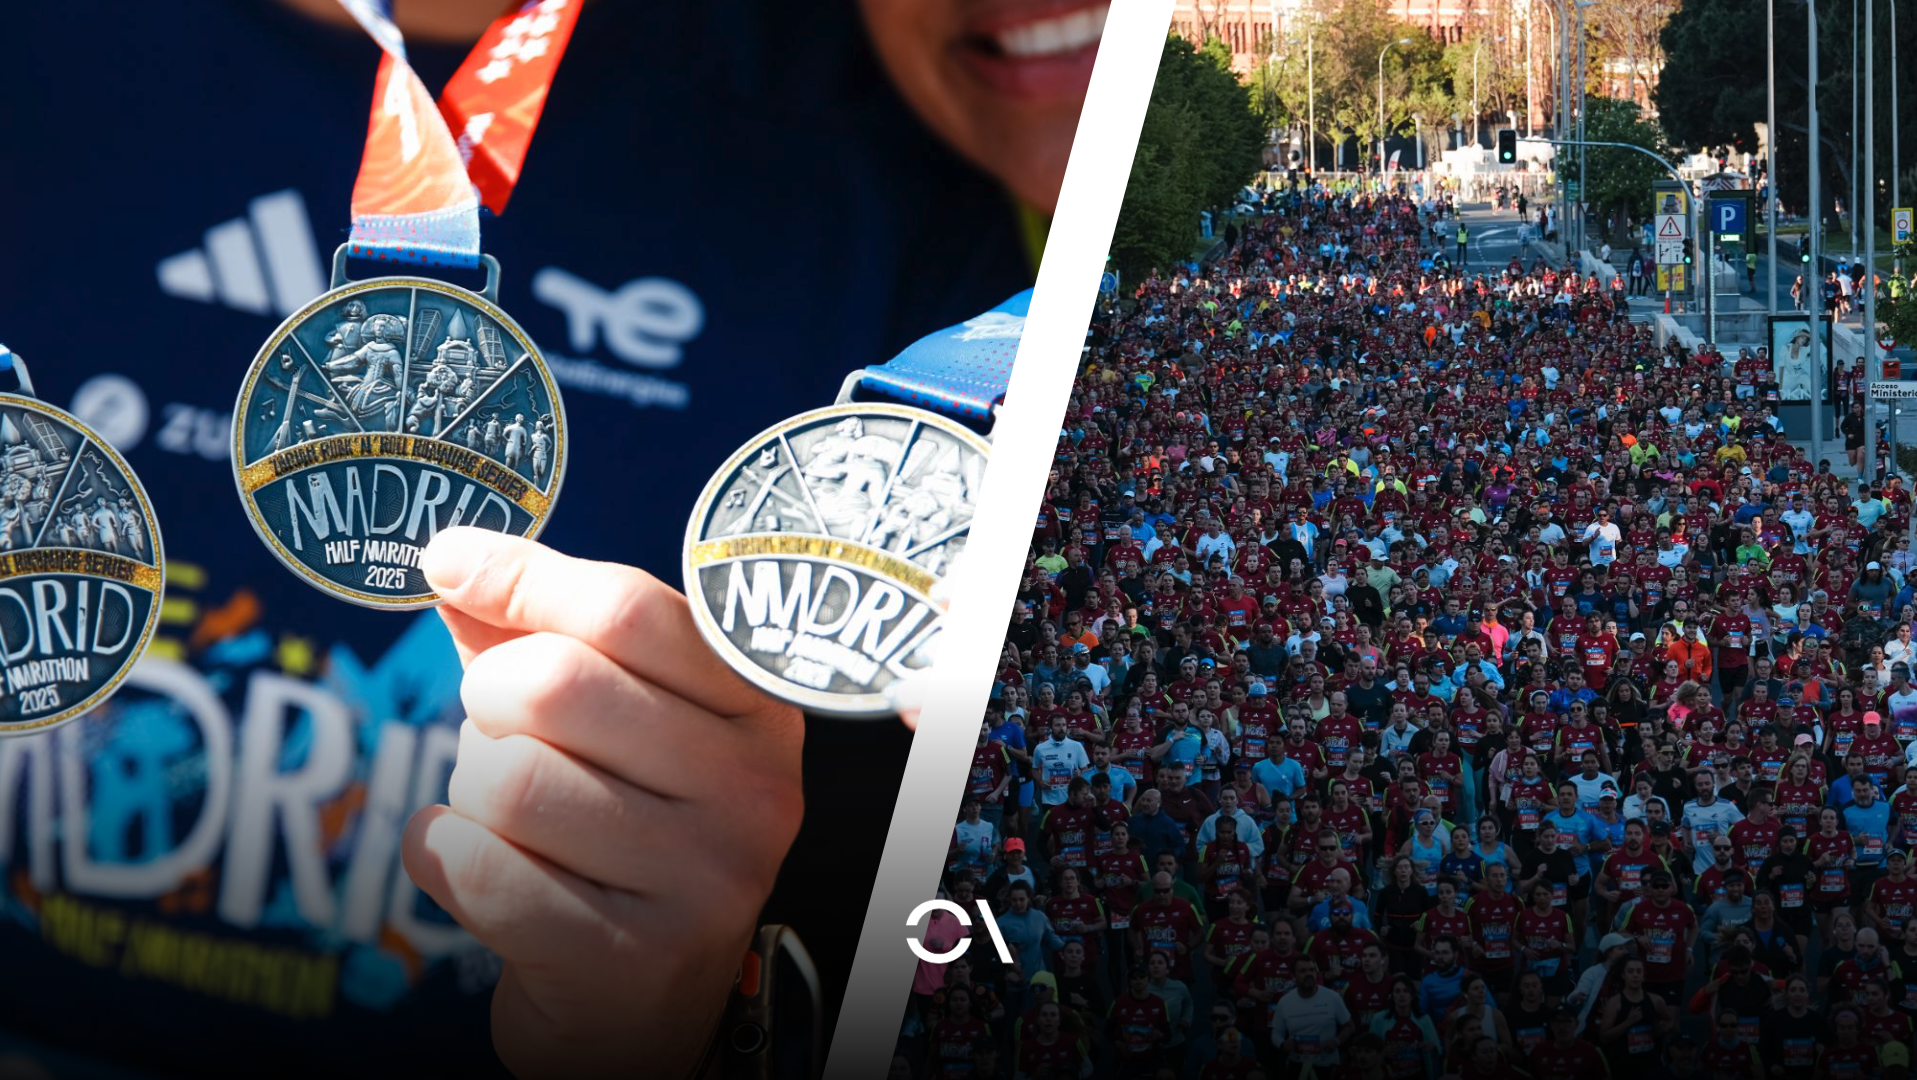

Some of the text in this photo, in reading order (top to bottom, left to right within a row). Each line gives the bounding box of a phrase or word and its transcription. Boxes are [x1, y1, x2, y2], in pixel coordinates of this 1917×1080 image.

[1720, 206, 1736, 231] P
[476, 460, 529, 502] SERIES
[325, 538, 424, 569] HALF MARATH
[364, 565, 408, 590] 2025
[0, 579, 134, 668] DRID
[6, 657, 90, 695] MARATHON
[19, 684, 61, 716] 2025
